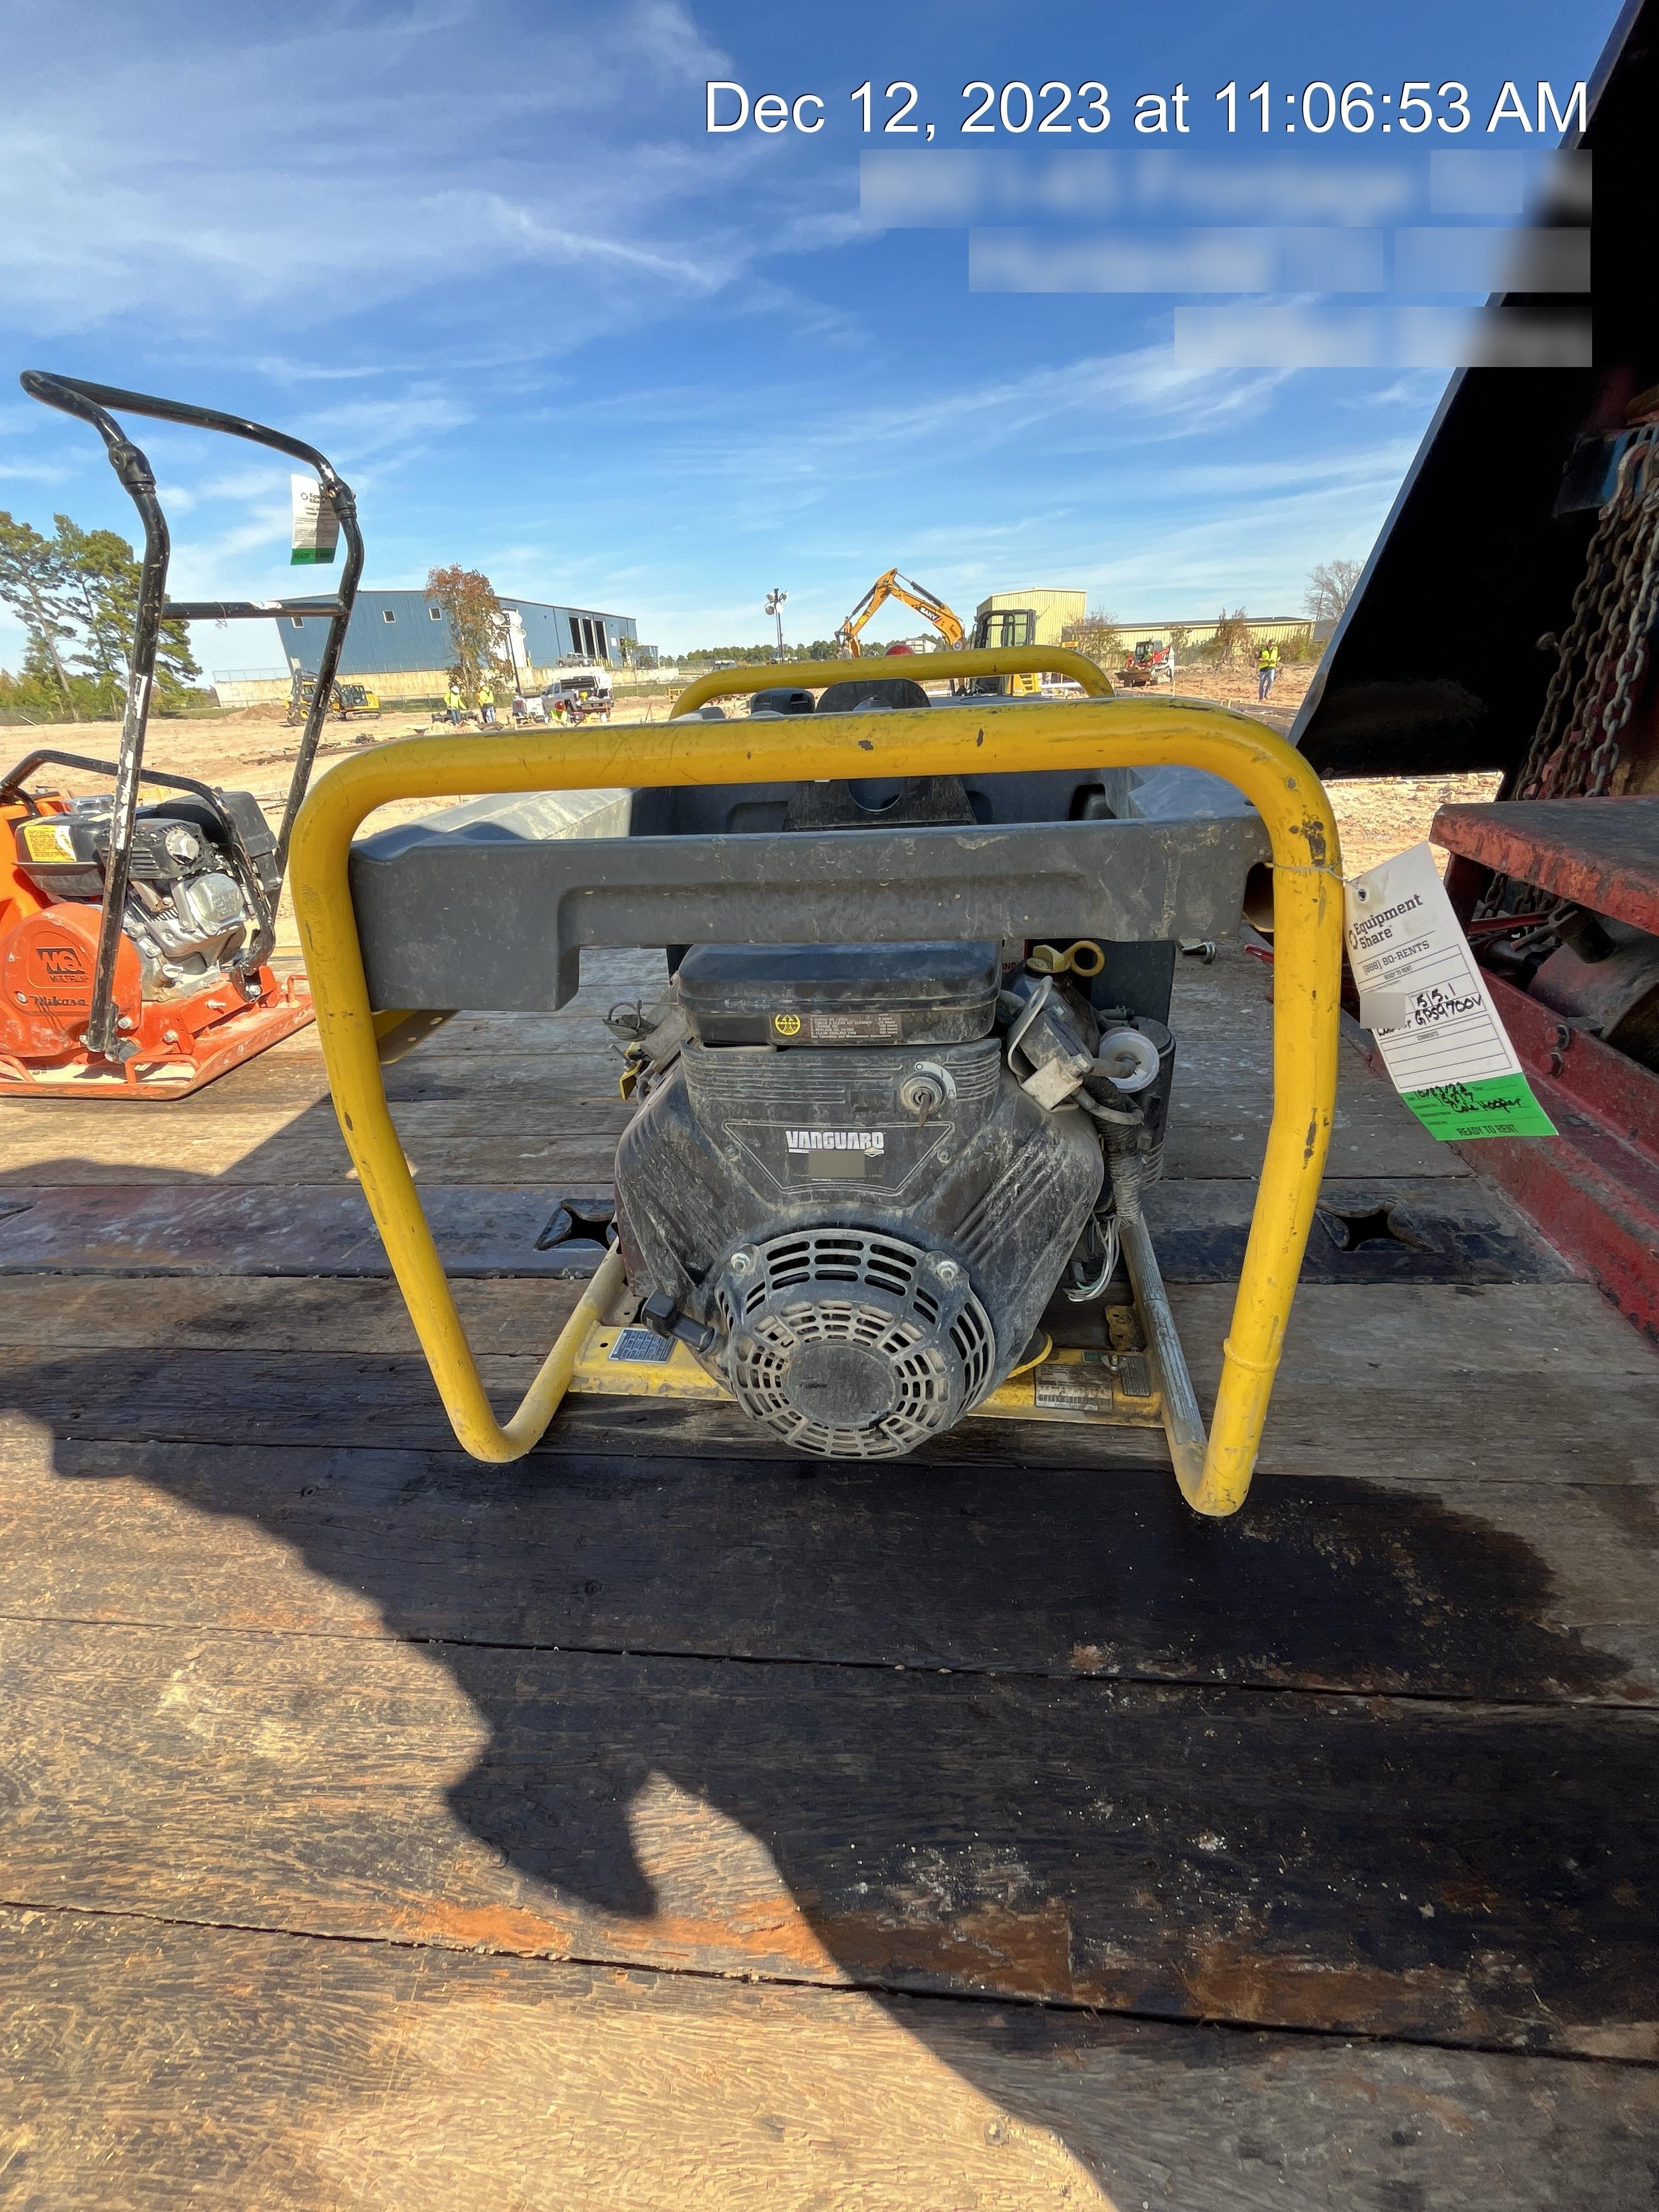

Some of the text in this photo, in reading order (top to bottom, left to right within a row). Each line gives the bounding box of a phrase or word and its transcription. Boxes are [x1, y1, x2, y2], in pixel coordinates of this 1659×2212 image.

[1353, 894, 1423, 935] Equipment
[1359, 928, 1393, 949] Share
[1457, 1124, 1520, 1136] READY TO RENT
